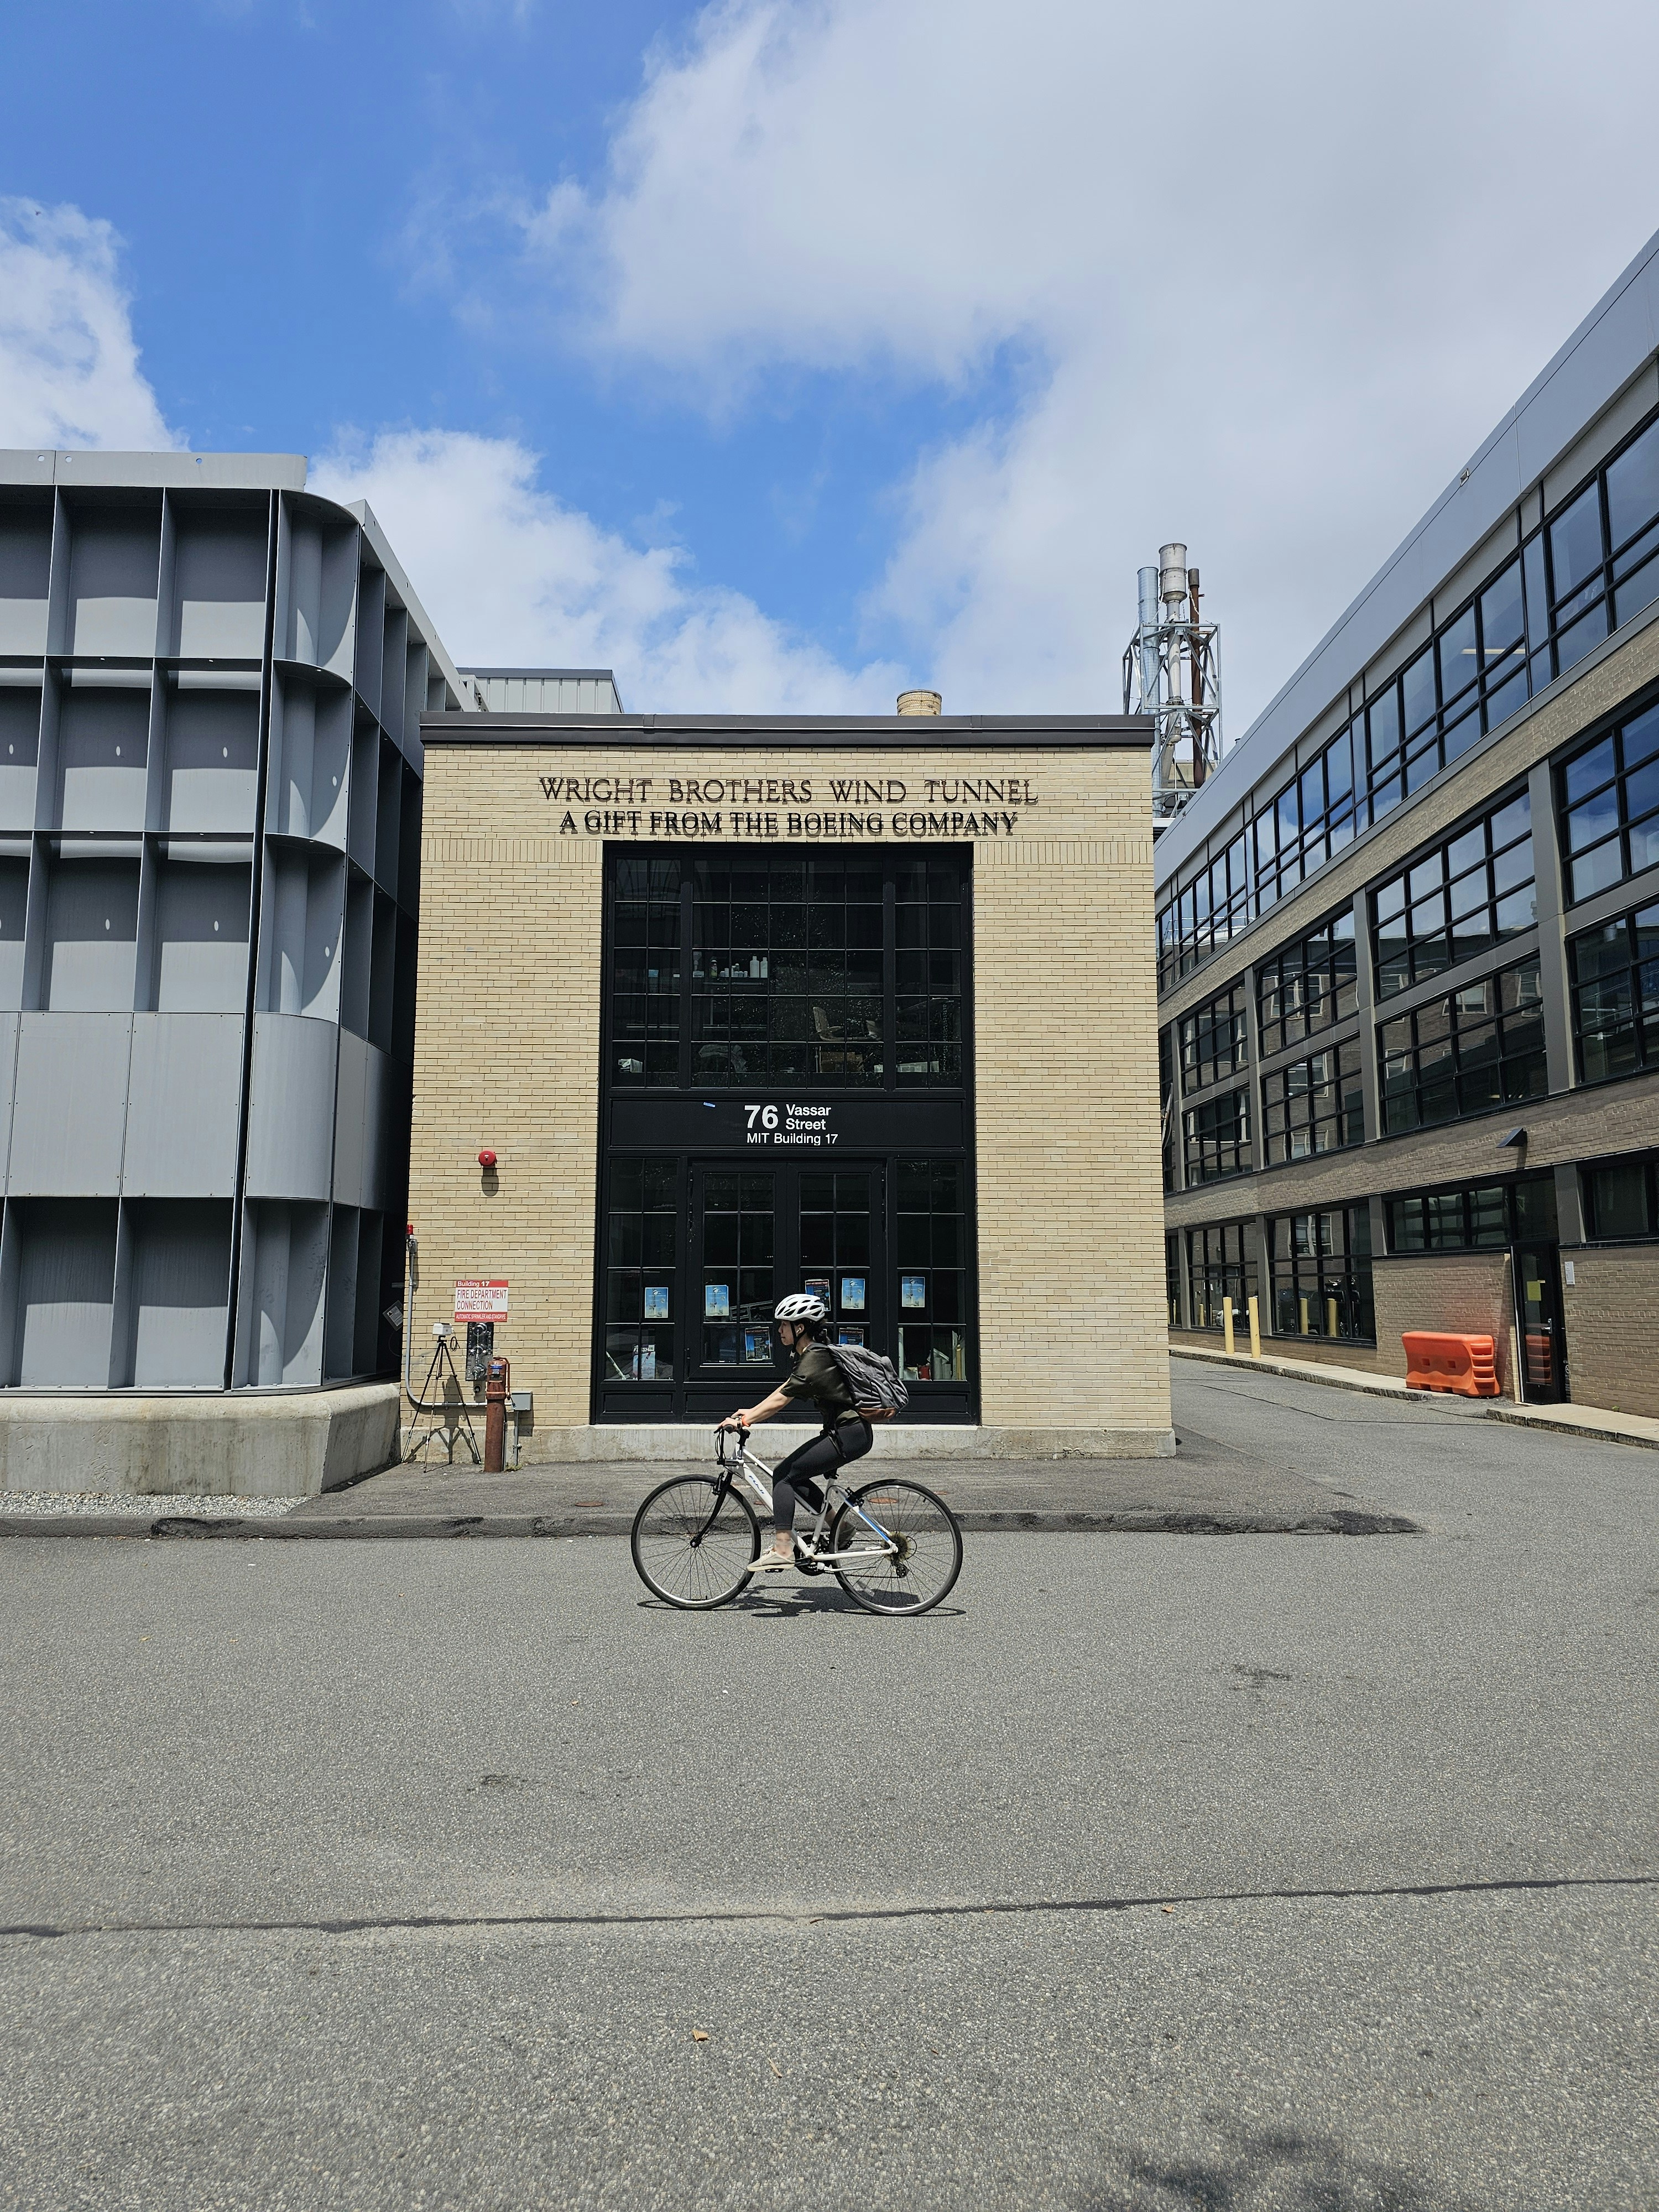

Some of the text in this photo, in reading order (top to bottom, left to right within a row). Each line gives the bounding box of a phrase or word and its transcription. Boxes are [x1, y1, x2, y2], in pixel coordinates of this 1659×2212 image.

[540, 777, 1038, 803] WRIGHT BROTHERS WIND TUNNEL
[560, 810, 1018, 830] A GIFT FROM THE BOEING COMPANY
[786, 1104, 831, 1116] Vassar
[744, 1105, 778, 1129] 76
[785, 1118, 826, 1130] Street
[747, 1133, 838, 1145] MIT Building 17
[457, 1290, 507, 1298] FIRE DEPARTMENT
[457, 1301, 493, 1310] CONNECTION
